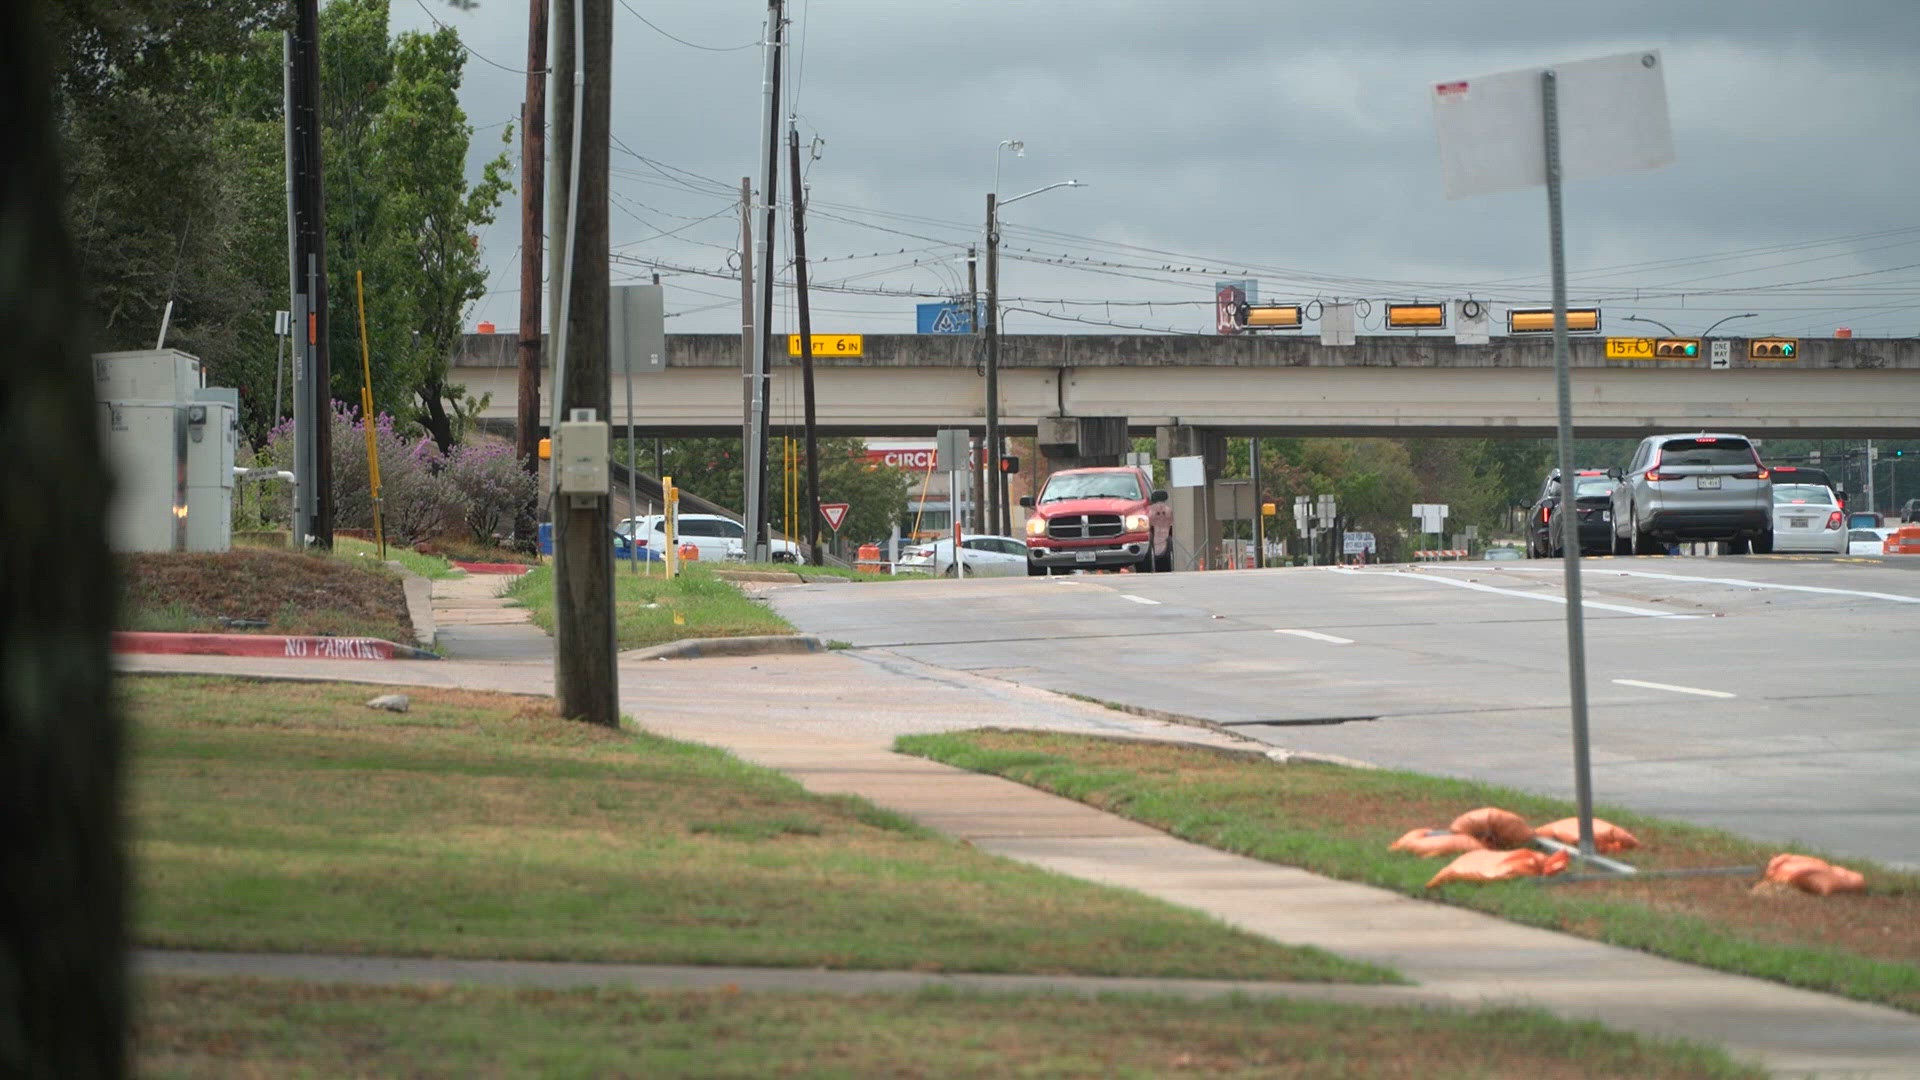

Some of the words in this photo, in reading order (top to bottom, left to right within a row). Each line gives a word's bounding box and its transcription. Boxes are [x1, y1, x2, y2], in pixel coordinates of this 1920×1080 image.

[813, 343, 824, 351] FT
[836, 339, 846, 351] 6
[848, 343, 858, 351] IN
[1612, 341, 1625, 354] 15
[884, 452, 938, 467] CIRCL
[285, 638, 307, 657] NO
